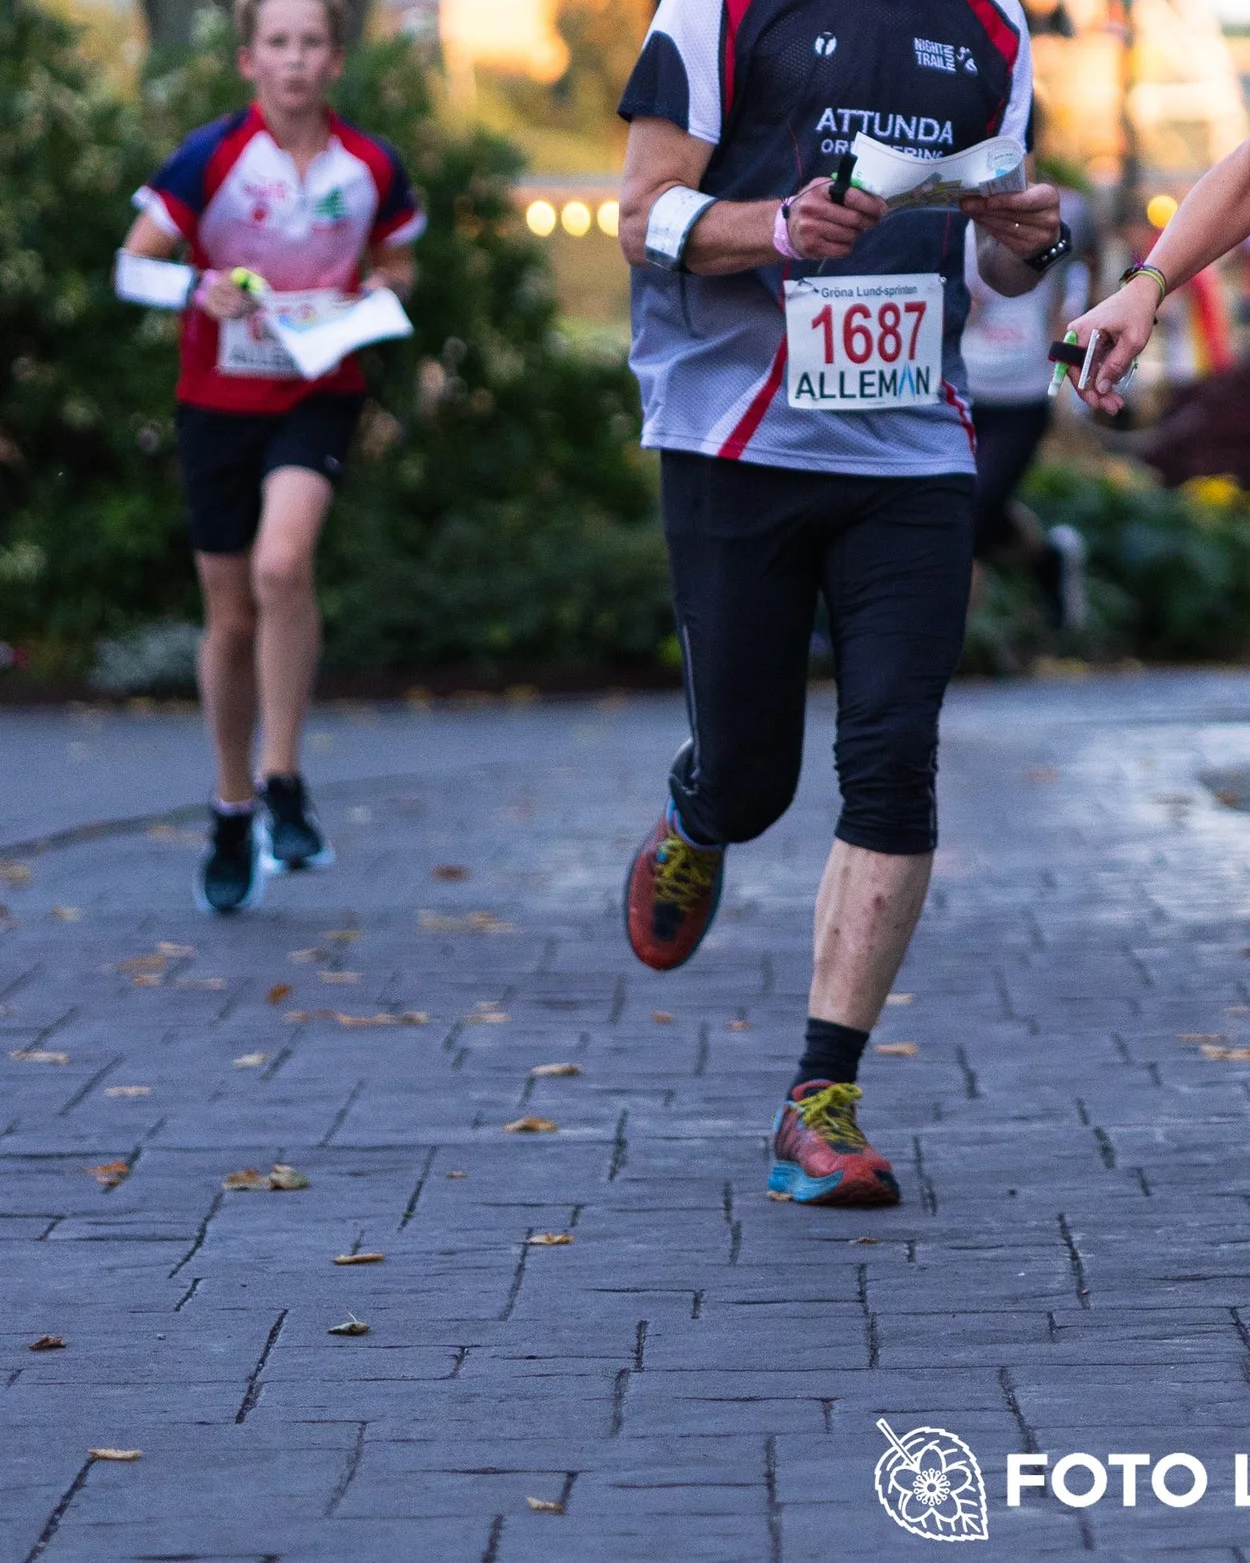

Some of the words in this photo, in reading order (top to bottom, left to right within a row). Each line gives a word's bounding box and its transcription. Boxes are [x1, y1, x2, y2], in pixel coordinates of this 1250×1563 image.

[913, 37, 945, 55] NIGHT
[915, 51, 947, 70] TRAIL
[815, 107, 954, 144] ATTUNDA
[821, 286, 854, 298] Gröna
[856, 284, 918, 298] Lund-sprinten
[811, 300, 927, 365] 1687
[795, 362, 930, 400] ALLEMAN
